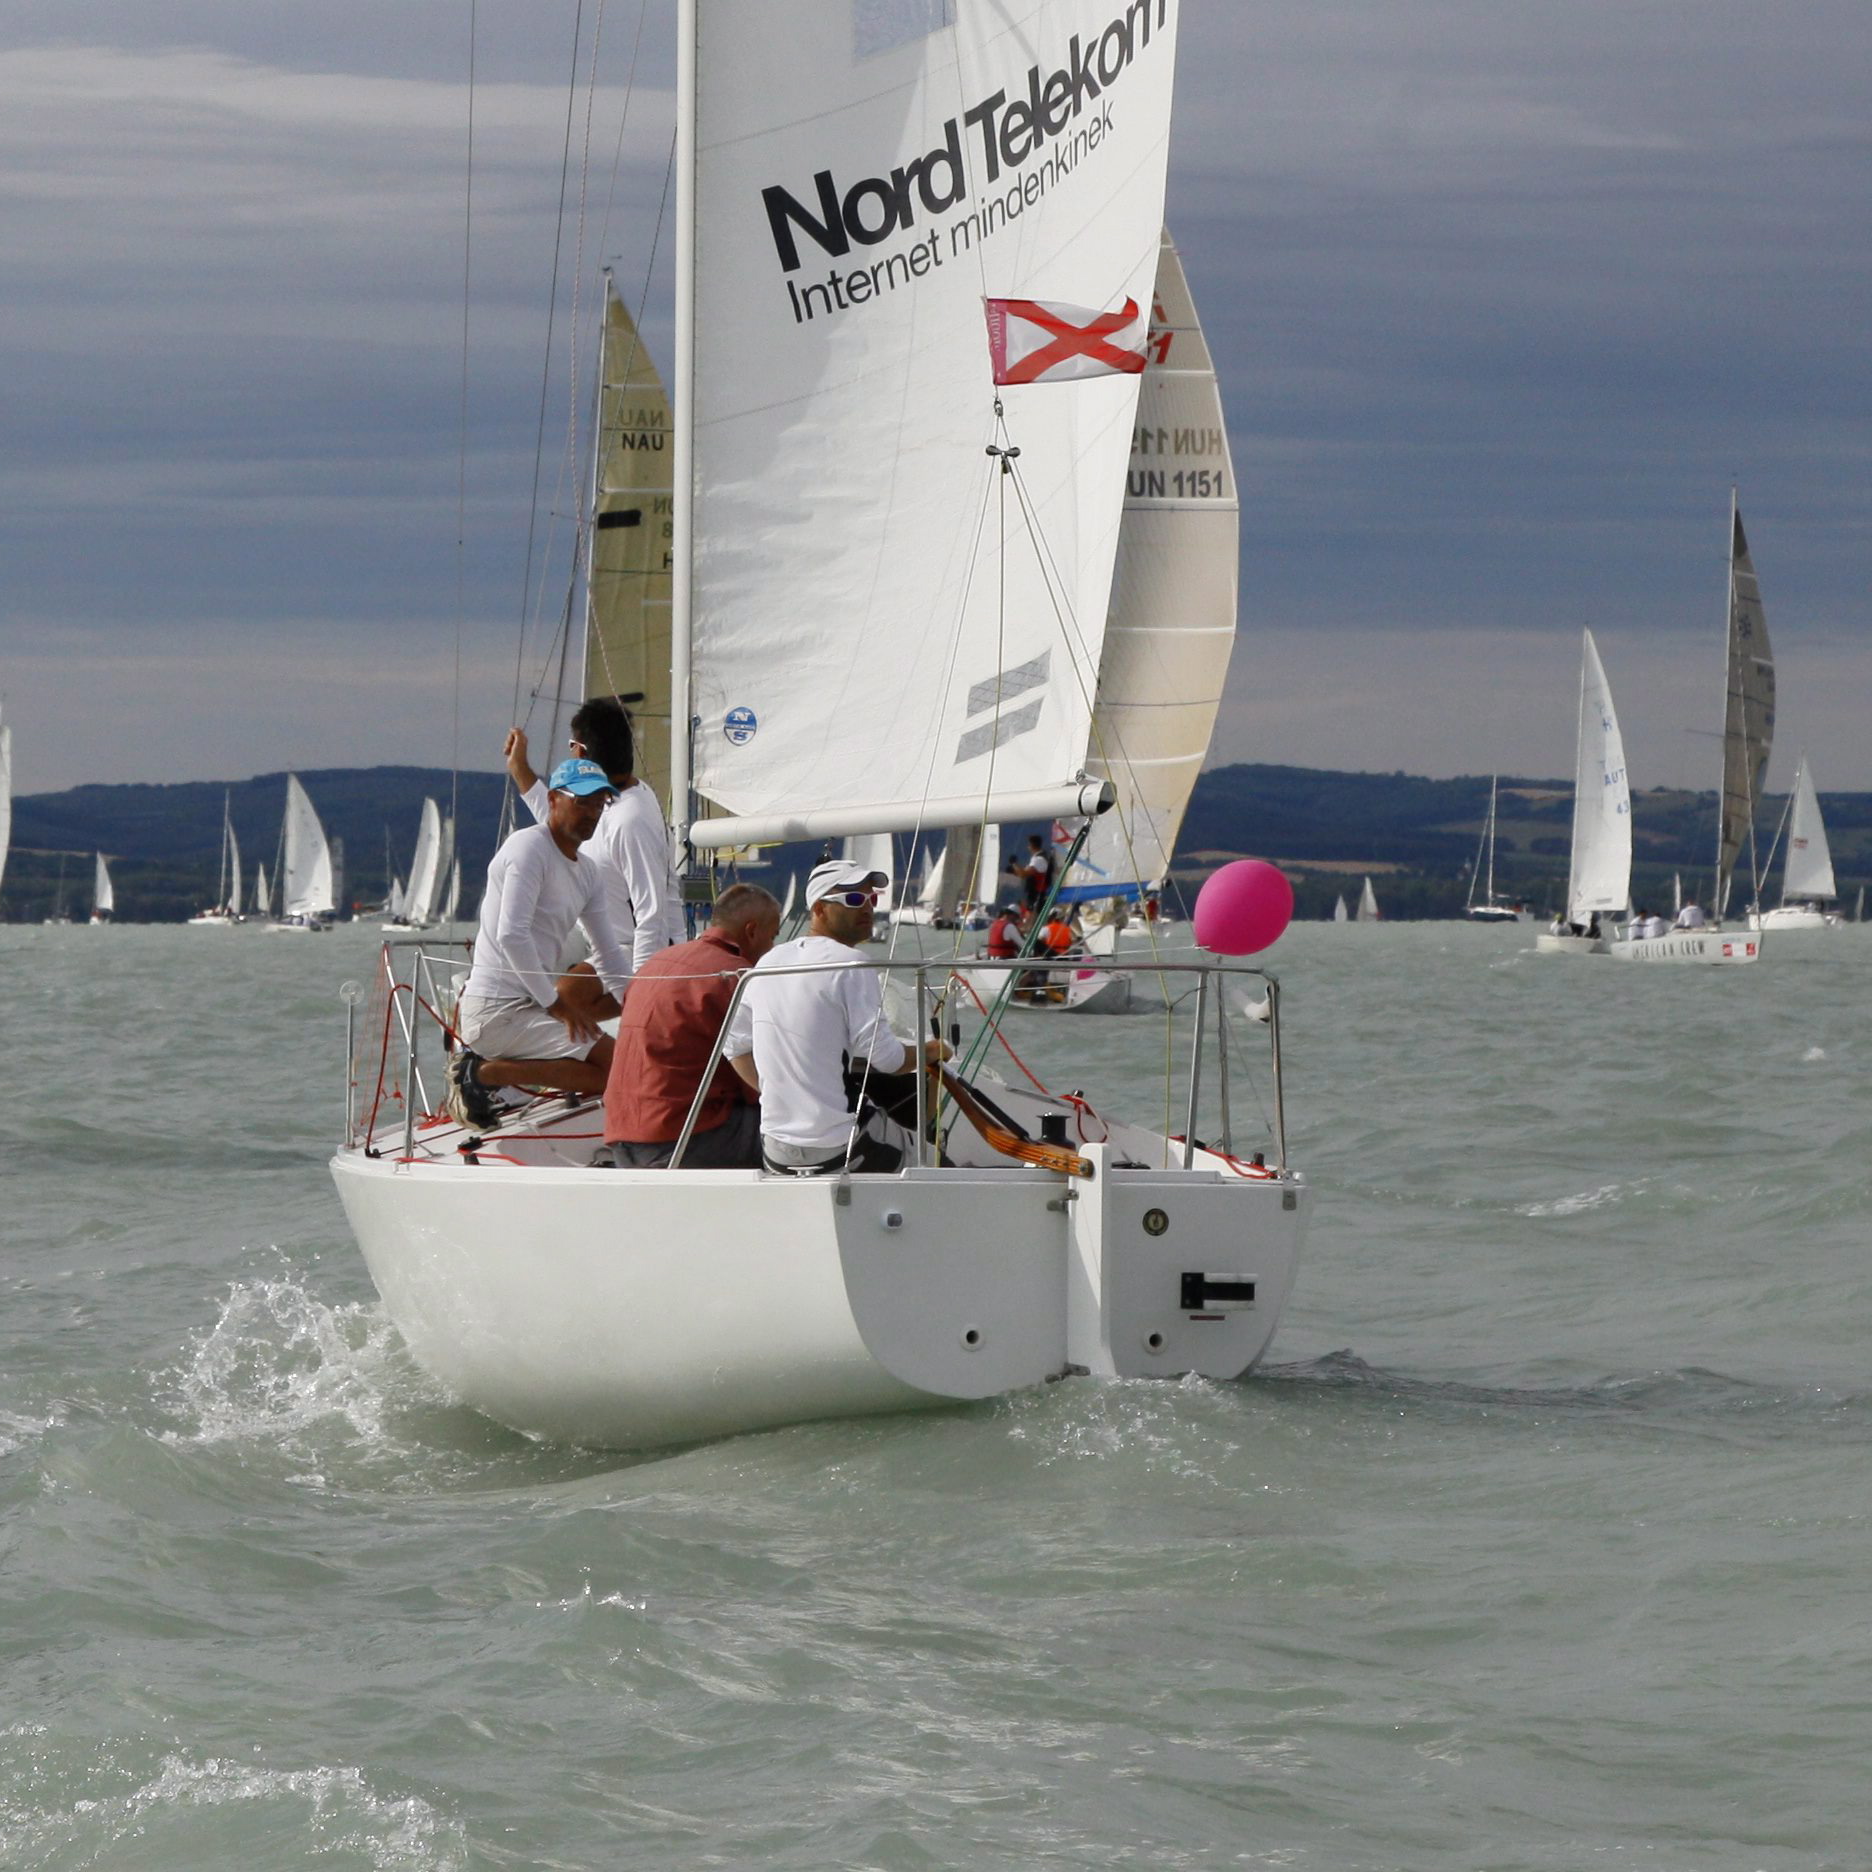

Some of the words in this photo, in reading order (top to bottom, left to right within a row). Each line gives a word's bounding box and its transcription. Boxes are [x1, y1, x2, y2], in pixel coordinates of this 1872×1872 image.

[761, 117, 967, 274] Nord
[786, 229, 943, 324] Internet
[951, 99, 1116, 259] mindenkinek
[622, 434, 664, 451] NAU
[1172, 470, 1223, 497] 1151
